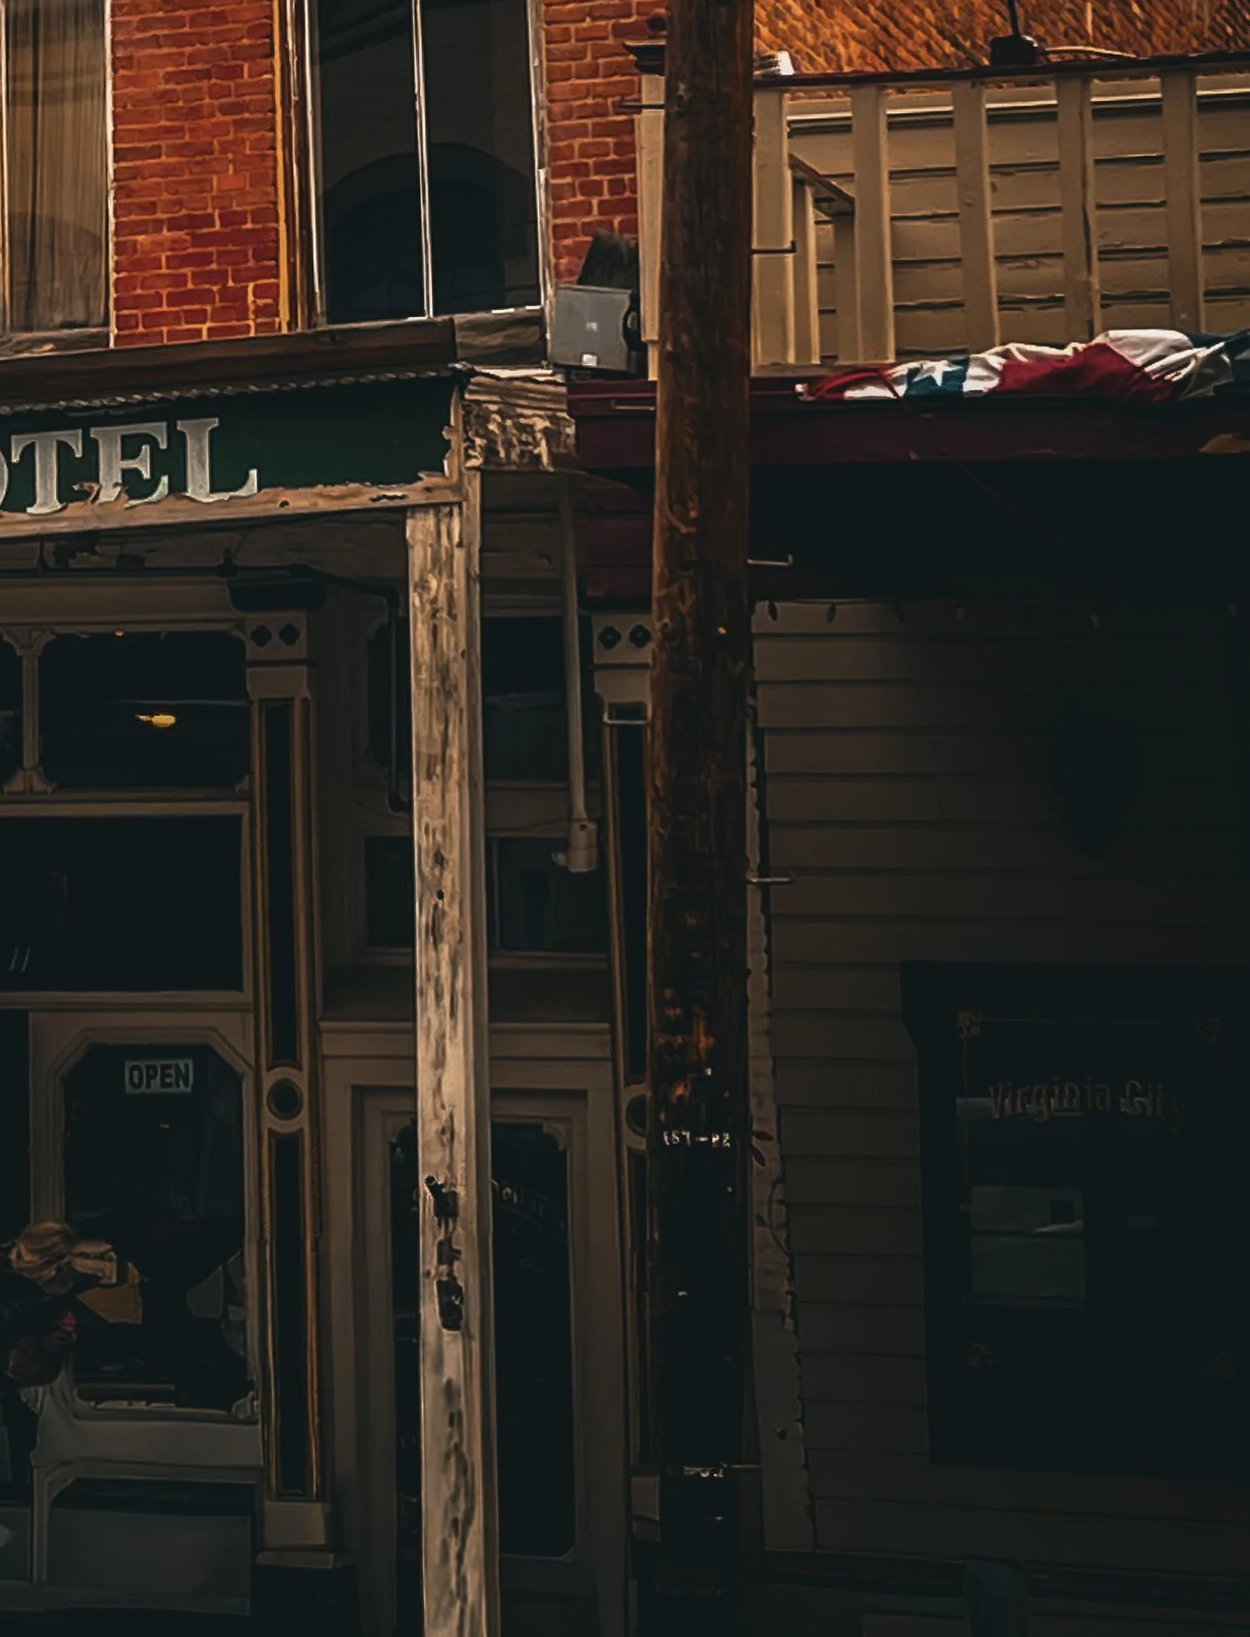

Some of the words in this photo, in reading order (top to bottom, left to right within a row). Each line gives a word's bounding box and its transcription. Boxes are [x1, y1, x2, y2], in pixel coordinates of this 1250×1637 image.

[129, 1063, 189, 1090] OPEN
[988, 1075, 1112, 1123] Virginia
[1118, 1079, 1188, 1135] City
